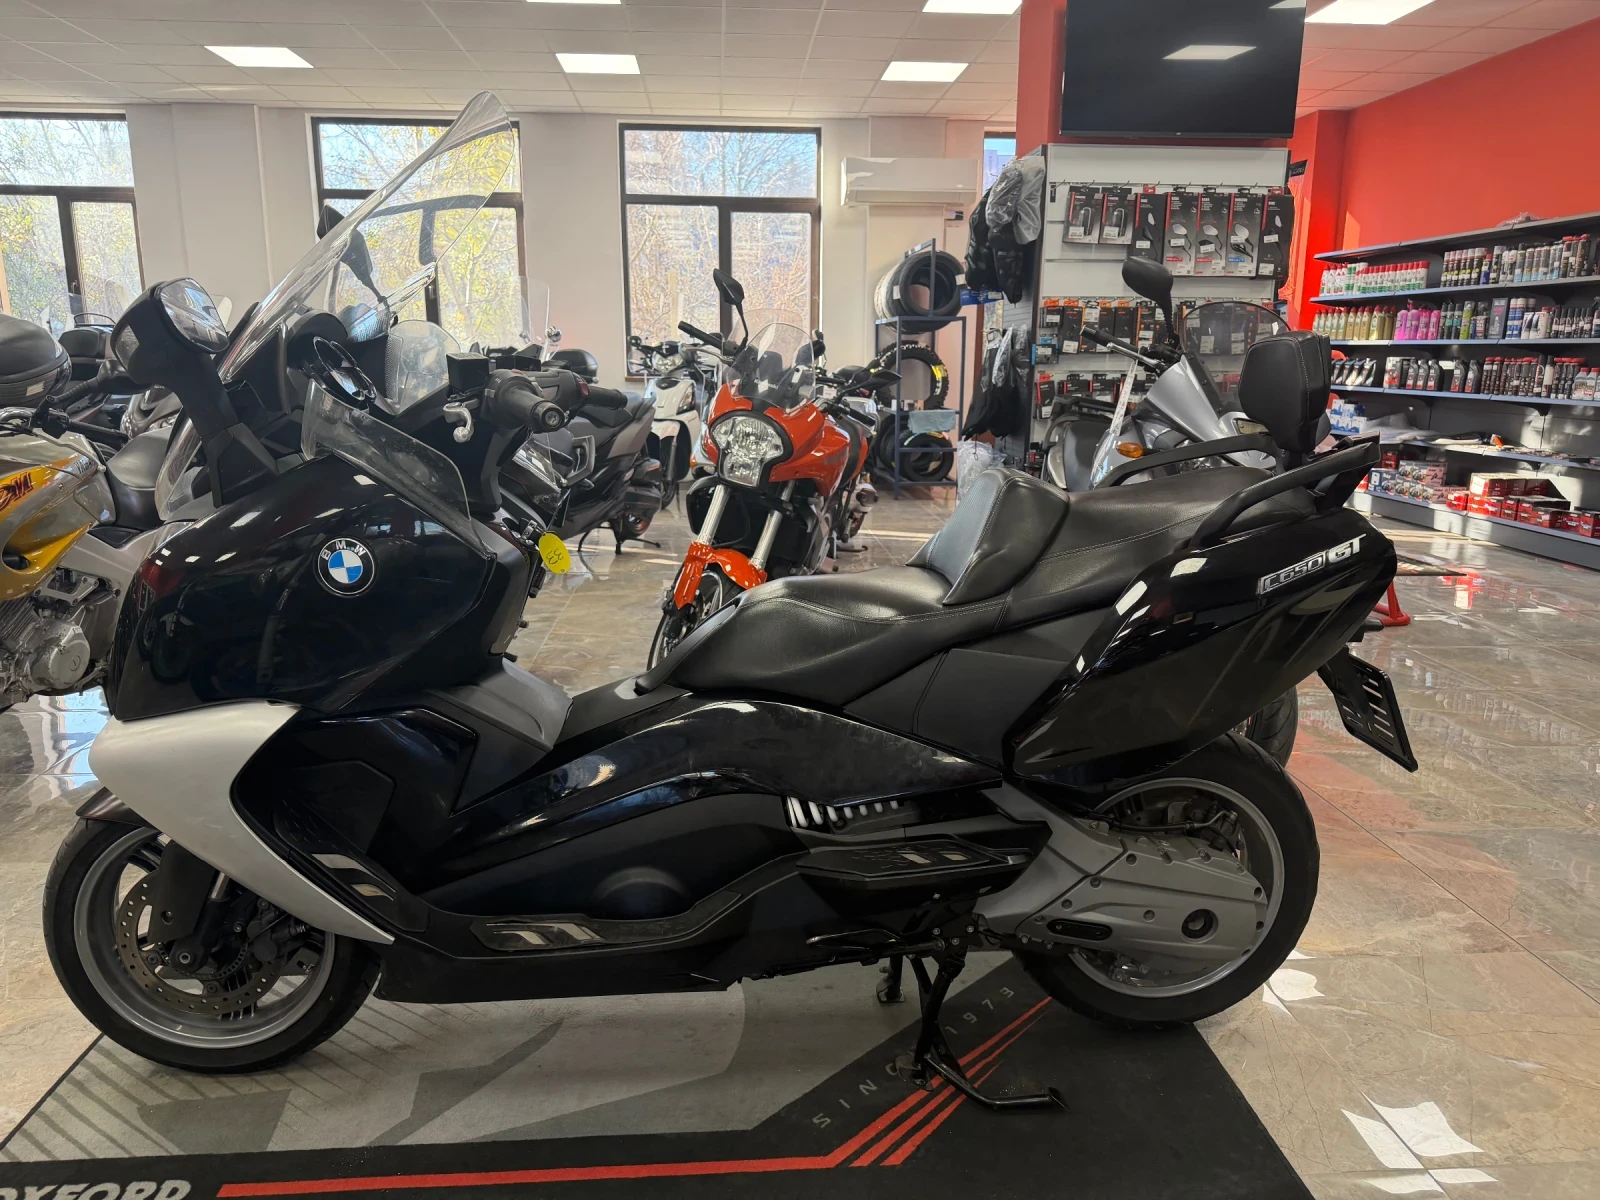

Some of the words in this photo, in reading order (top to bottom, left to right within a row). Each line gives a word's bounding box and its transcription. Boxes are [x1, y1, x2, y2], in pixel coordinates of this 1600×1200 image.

[320, 540, 366, 561] BMW
[1328, 533, 1366, 563] GT
[945, 986, 1015, 1035] 1973
